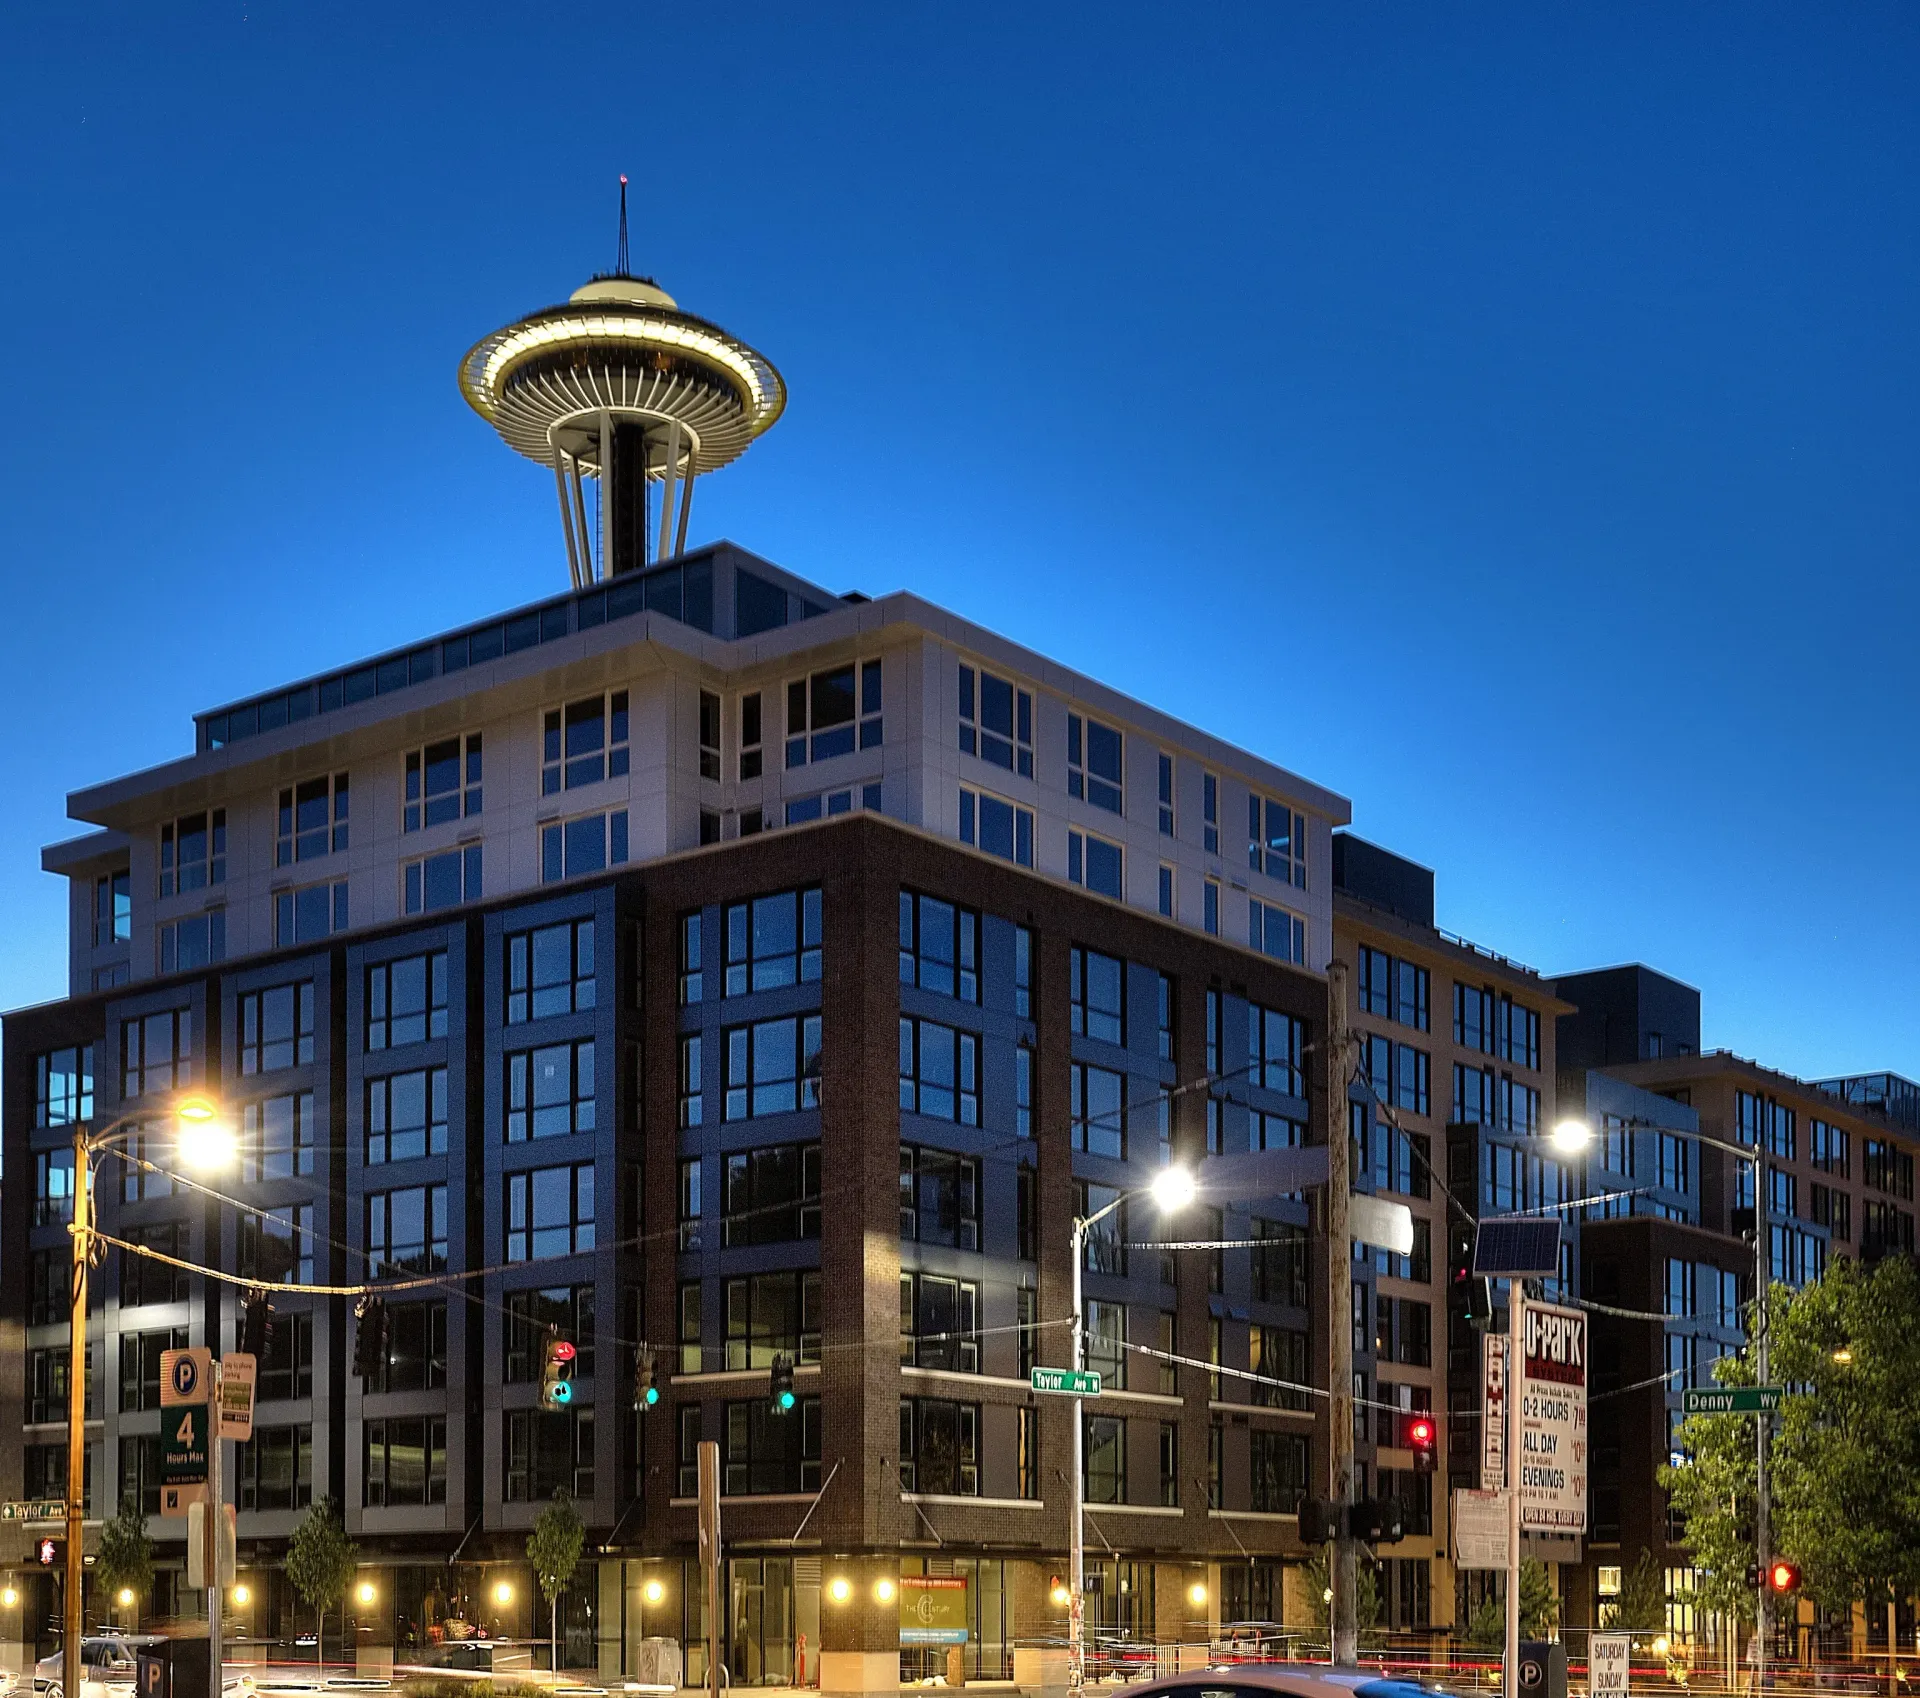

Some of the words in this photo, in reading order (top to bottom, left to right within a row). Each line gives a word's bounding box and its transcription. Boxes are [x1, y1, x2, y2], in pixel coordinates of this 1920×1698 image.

[1036, 1372, 1062, 1390] Taylor
[1074, 1377, 1087, 1391] Ave
[1092, 1378, 1098, 1392] N
[1523, 1396, 1538, 1417] 0-2
[1541, 1399, 1569, 1422] HOURS
[1689, 1394, 1733, 1411] Denny
[1760, 1393, 1777, 1409] Wy
[177, 1411, 195, 1449] 4
[1523, 1431, 1539, 1453] ALL
[1541, 1433, 1558, 1455] DAY
[167, 1452, 187, 1464] Hours
[189, 1451, 204, 1463] Max
[1523, 1466, 1564, 1489] EVENINGS
[13, 1504, 42, 1520] Taylor
[50, 1506, 62, 1516] Ave
[1595, 1643, 1625, 1660] SATURDAY
[149, 1663, 160, 1694] P
[1598, 1673, 1622, 1688] SUNDAY
